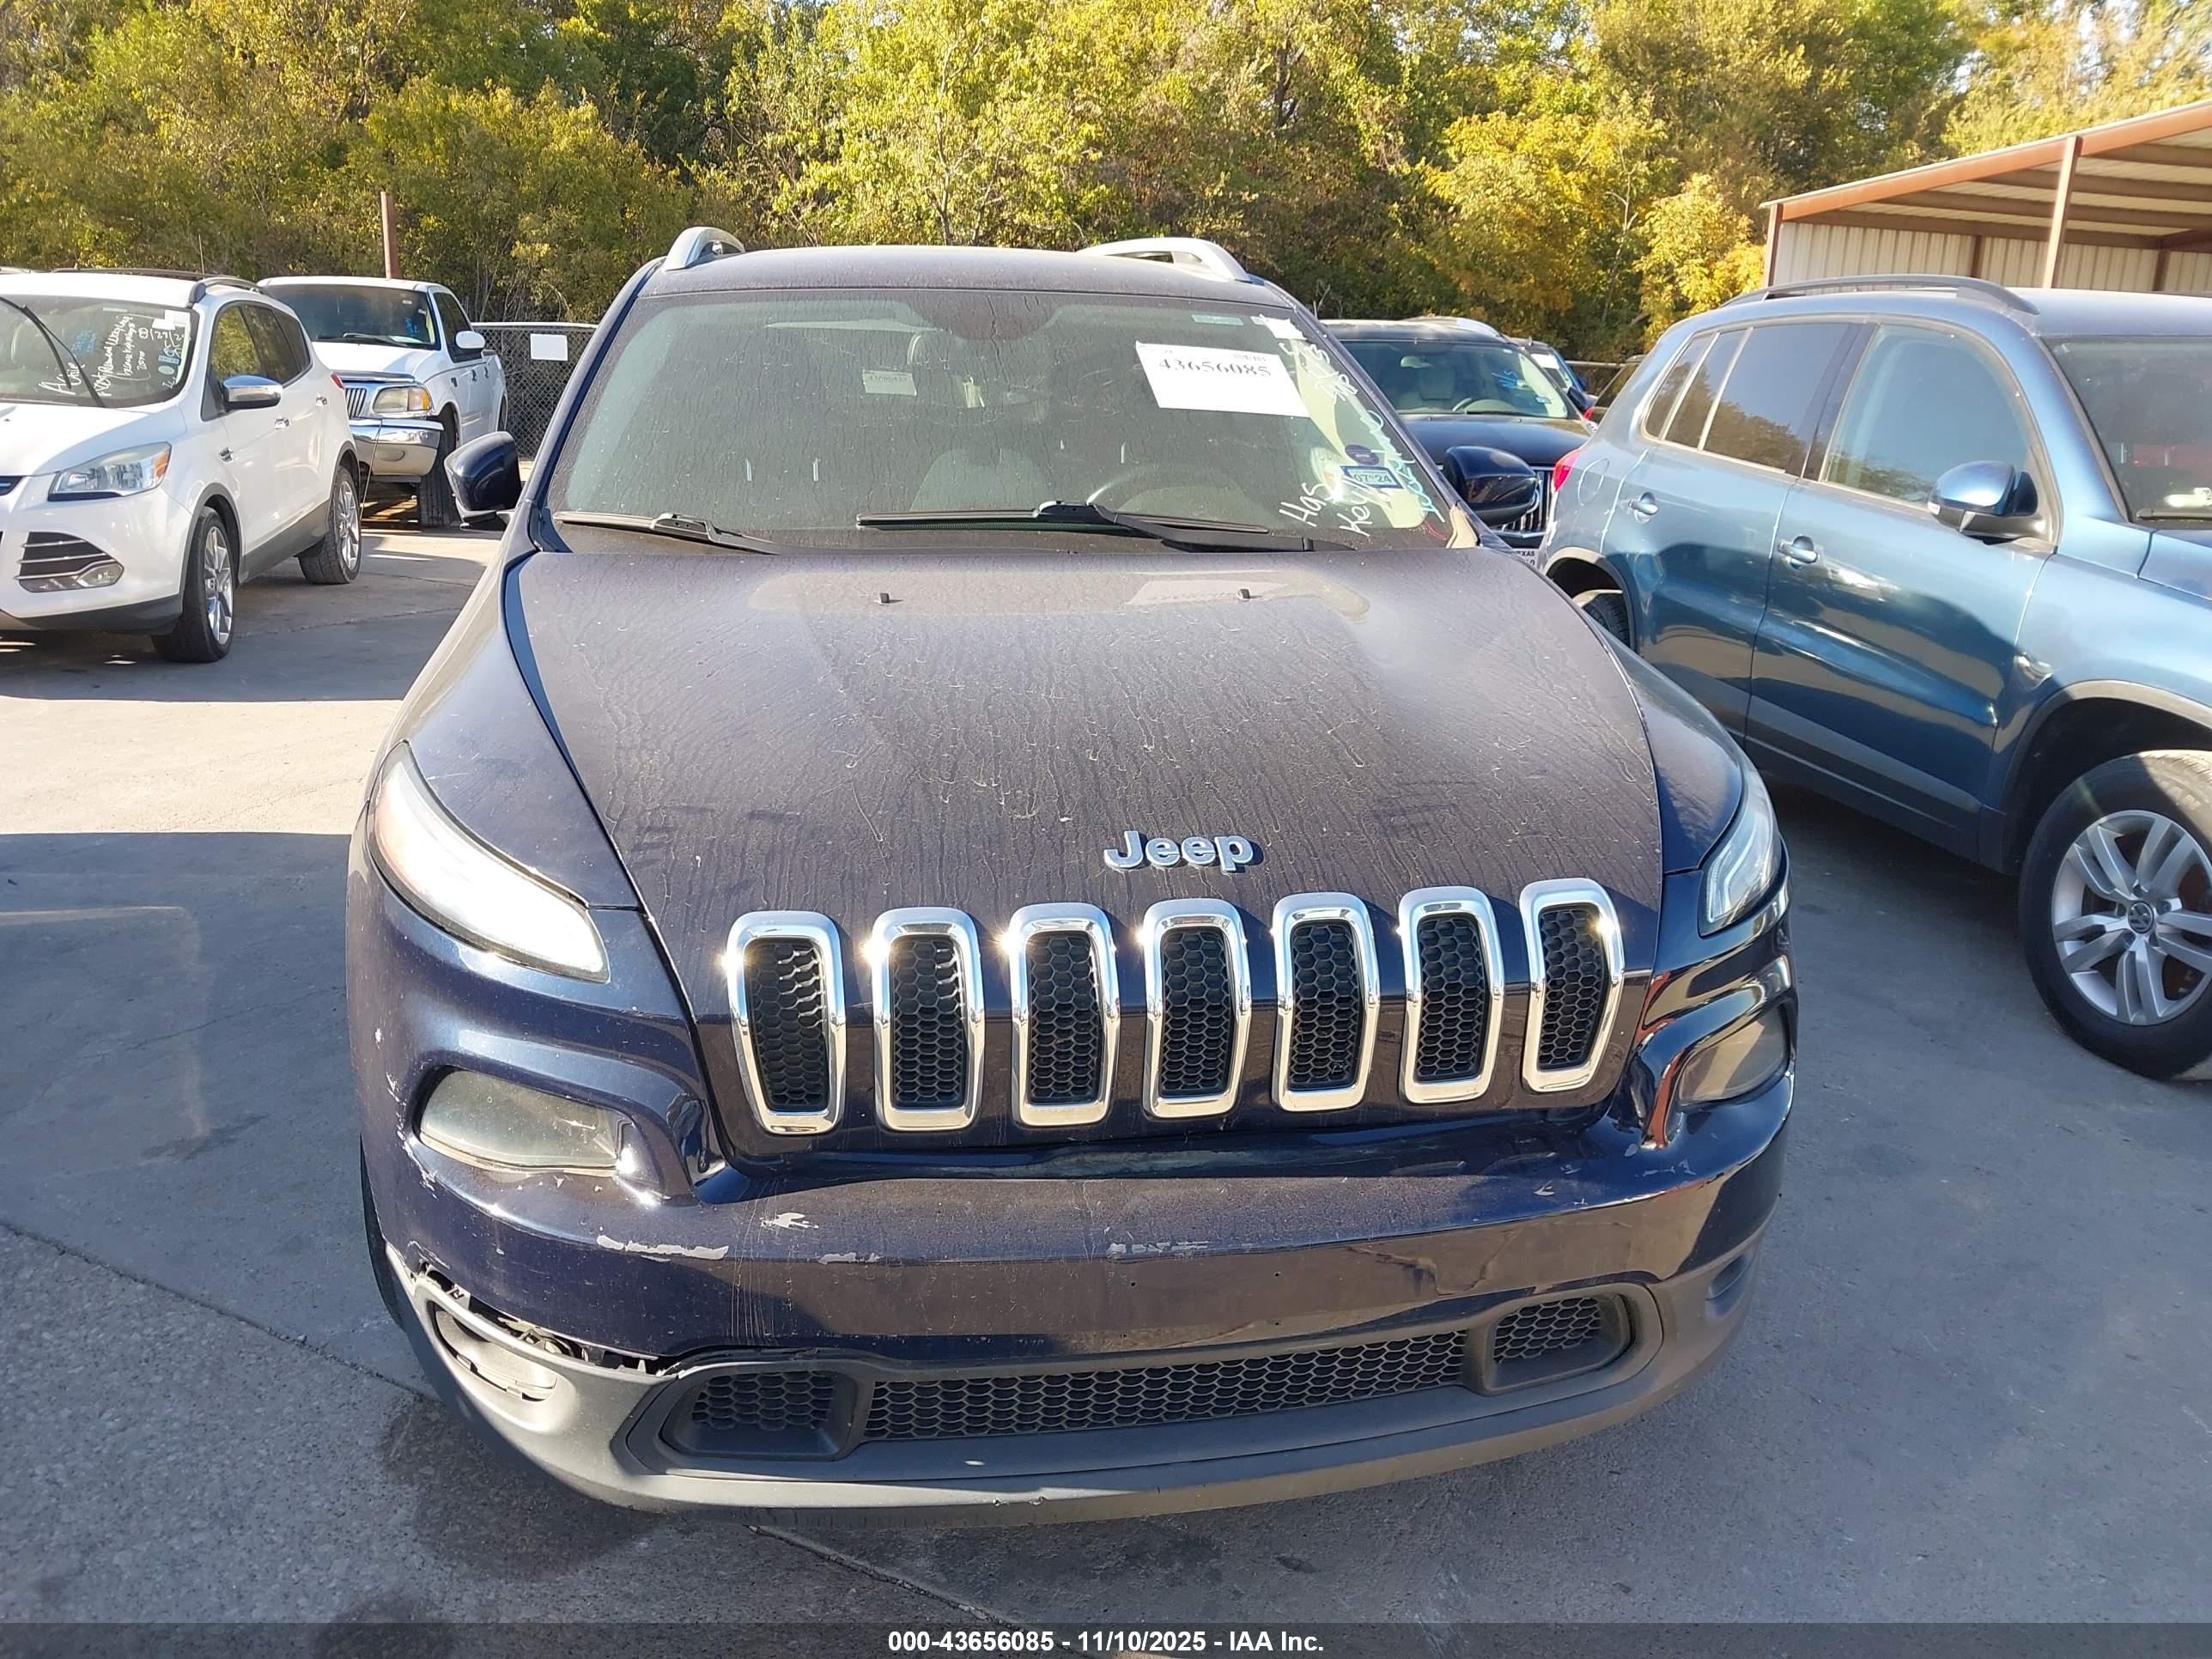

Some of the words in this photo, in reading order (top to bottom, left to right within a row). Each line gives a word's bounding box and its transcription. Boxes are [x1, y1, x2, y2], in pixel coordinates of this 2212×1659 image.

[1158, 358, 1272, 378] 43656085
[1279, 482, 1336, 527] Has
[1103, 830, 1255, 872] Jeep
